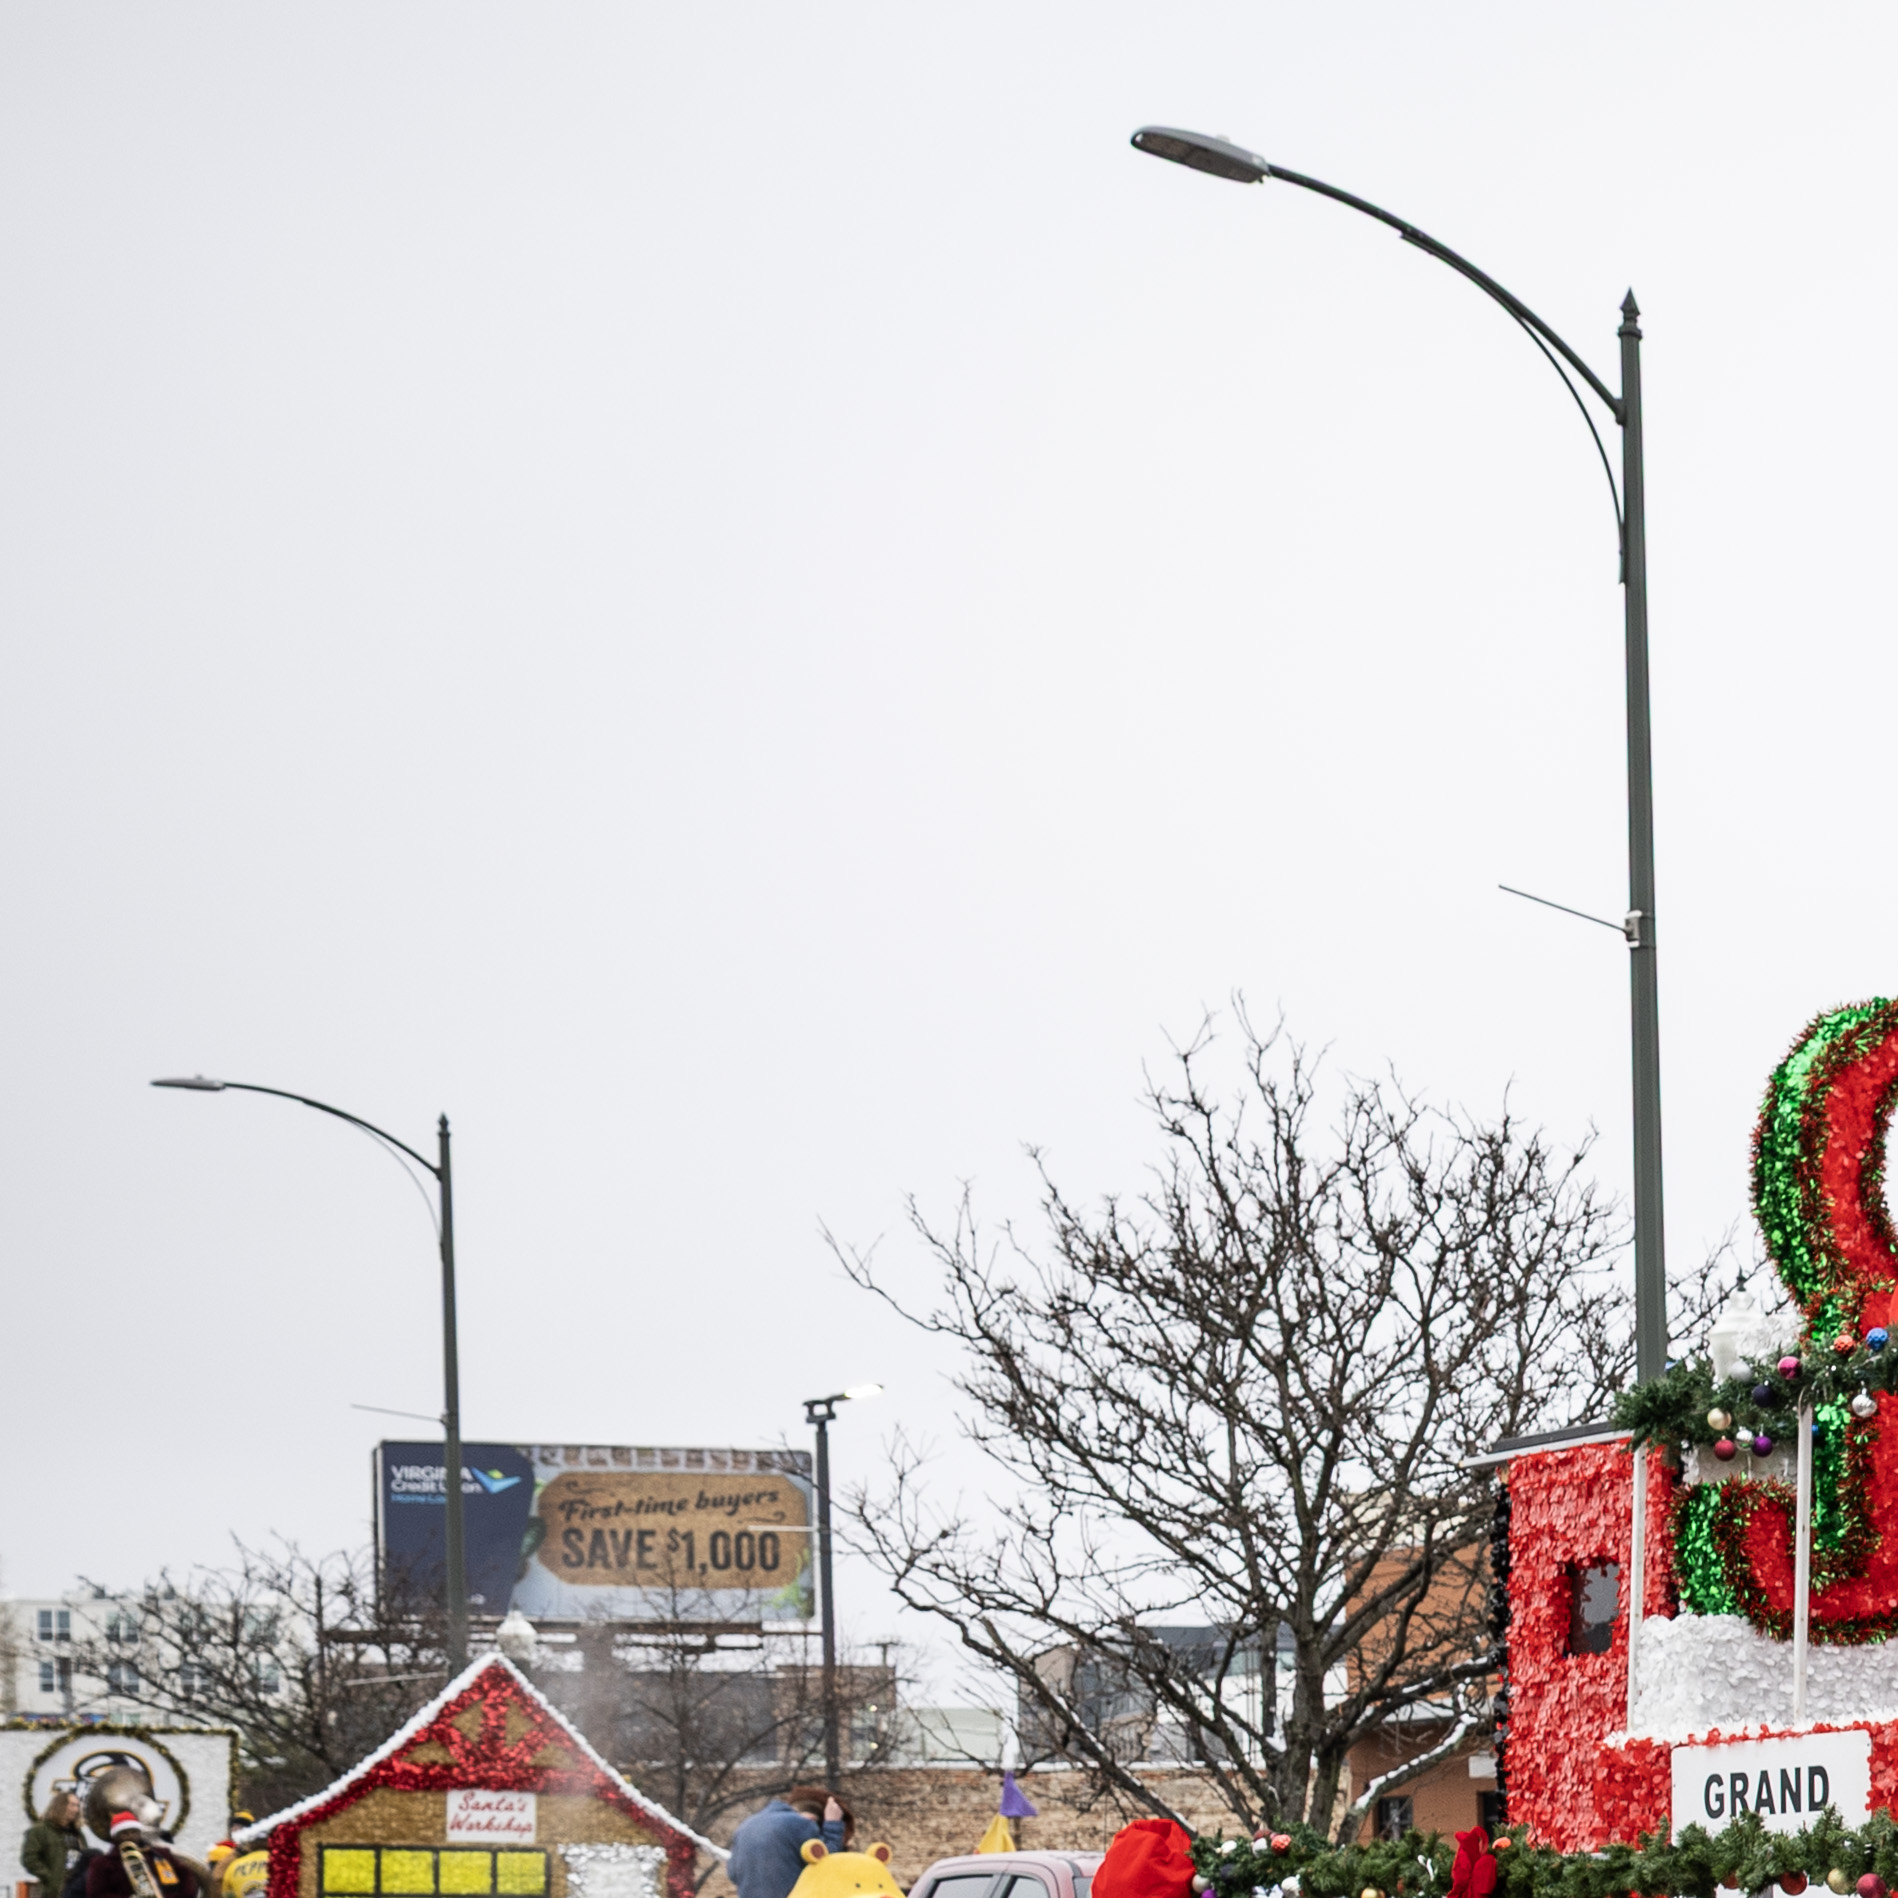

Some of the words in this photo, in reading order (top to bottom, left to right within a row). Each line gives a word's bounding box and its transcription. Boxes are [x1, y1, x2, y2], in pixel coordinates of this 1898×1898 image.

[391, 1465, 474, 1481] VIRGINA
[558, 1496, 687, 1522] First-time
[695, 1490, 780, 1517] buyers
[562, 1528, 656, 1571] SAVE
[666, 1527, 781, 1575] $1,000
[458, 1791, 527, 1811] Santa's
[1704, 1765, 1830, 1820] GRAND
[450, 1814, 532, 1838] Workshop
